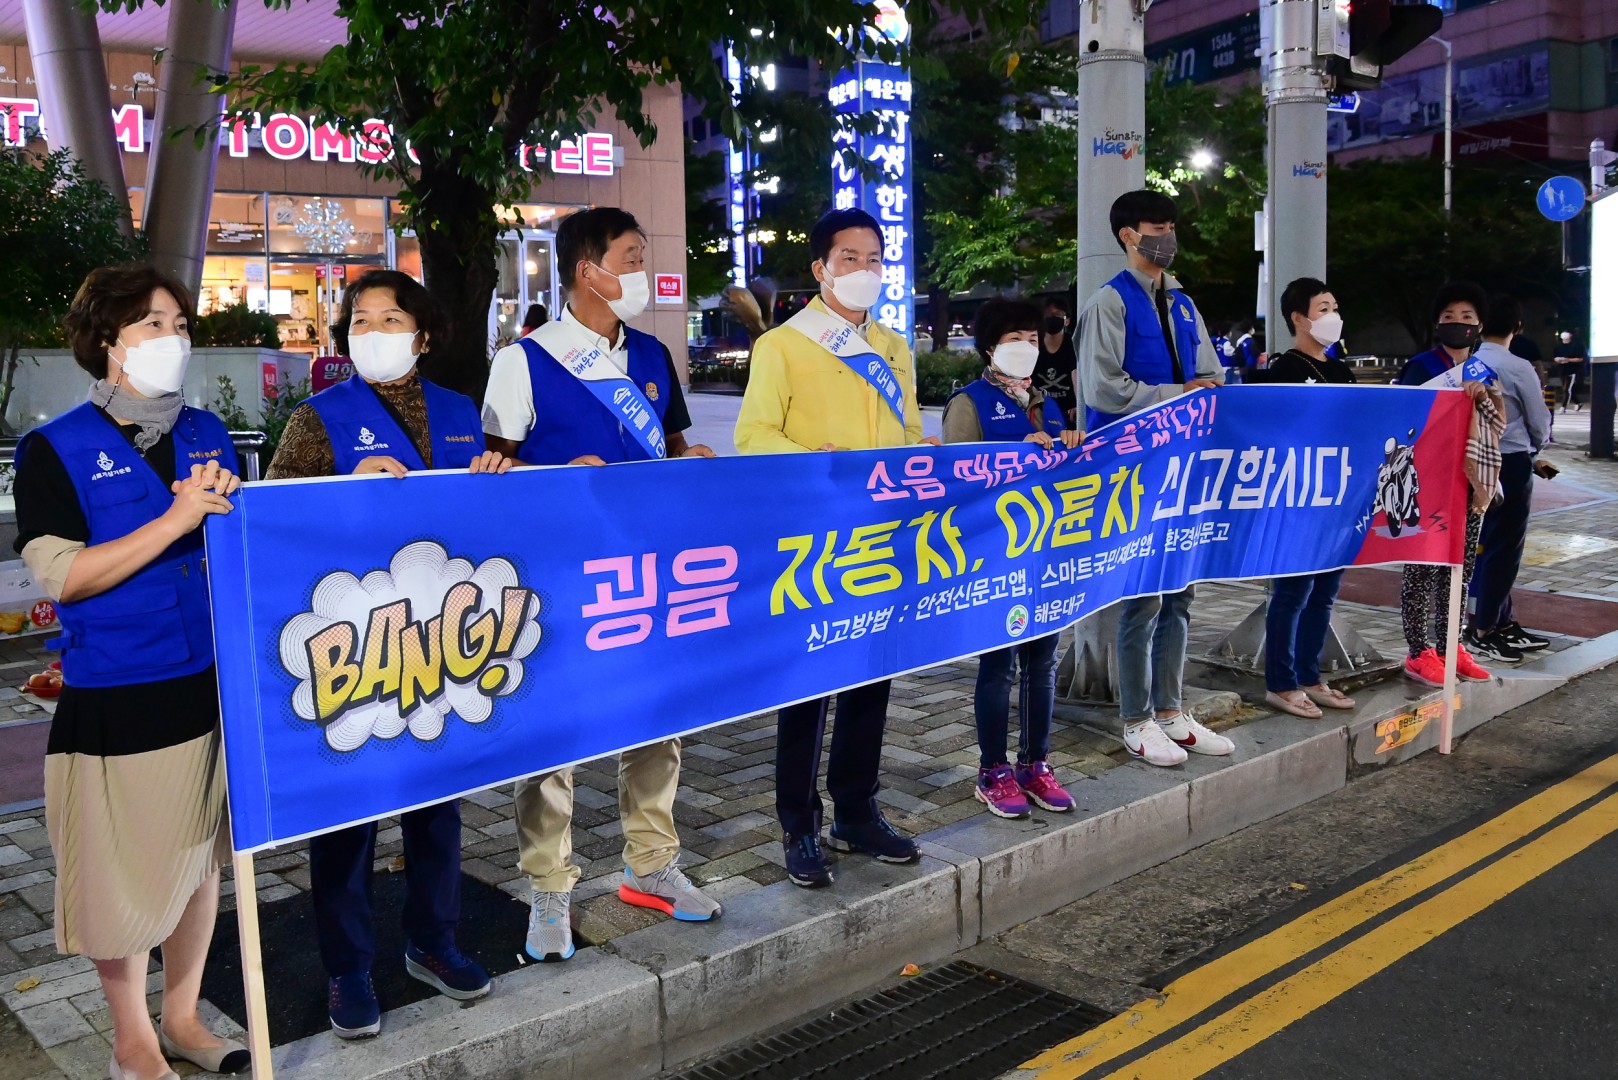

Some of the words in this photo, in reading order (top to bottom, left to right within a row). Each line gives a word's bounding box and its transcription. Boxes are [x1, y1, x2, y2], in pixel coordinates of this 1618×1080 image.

[864, 78, 912, 102] 해운대
[220, 109, 395, 165] TOMS
[573, 349, 601, 375] 해운대
[829, 327, 852, 353] 해운대
[866, 454, 946, 501] 소음
[581, 545, 740, 651] 굉음
[769, 505, 985, 616] 자동차,
[995, 463, 1145, 559] 이륜차
[1151, 445, 1352, 522] 신고합시다
[806, 605, 894, 653] 신고방법
[915, 568, 1034, 619] 안전신문고앱,
[1034, 592, 1087, 625] 해운대구
[304, 580, 532, 728] BANG!
